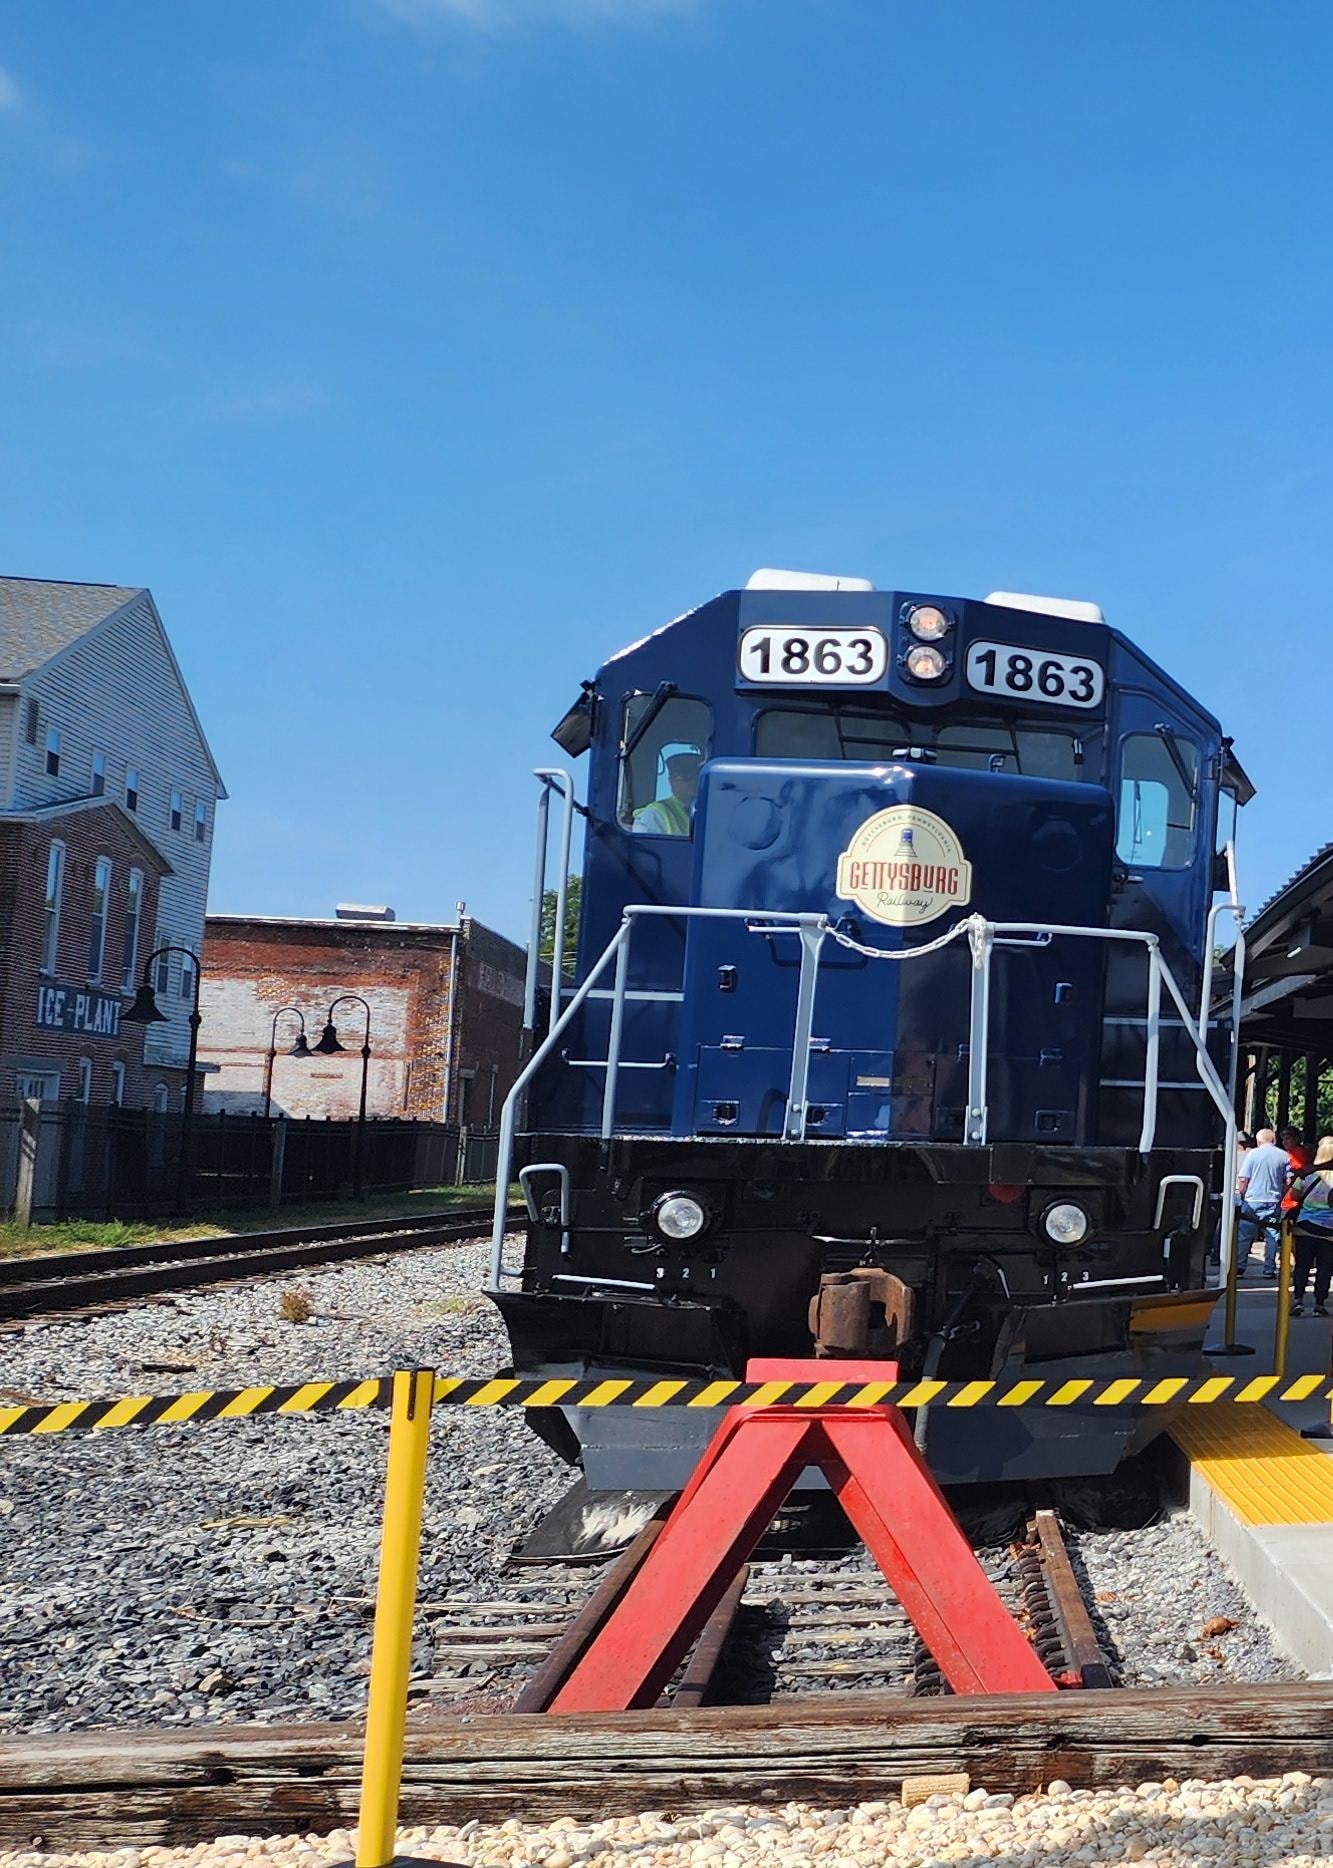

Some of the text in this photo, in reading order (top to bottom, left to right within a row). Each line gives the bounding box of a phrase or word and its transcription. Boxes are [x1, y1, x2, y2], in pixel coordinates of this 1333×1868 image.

[750, 637, 874, 675] 1863
[975, 649, 1095, 702] 1863
[850, 861, 958, 896] GETTYSBURG
[877, 892, 934, 914] Railway
[682, 1267, 690, 1278] 2
[710, 1268, 716, 1279] 1
[1043, 1271, 1089, 1285] 1 2 3
